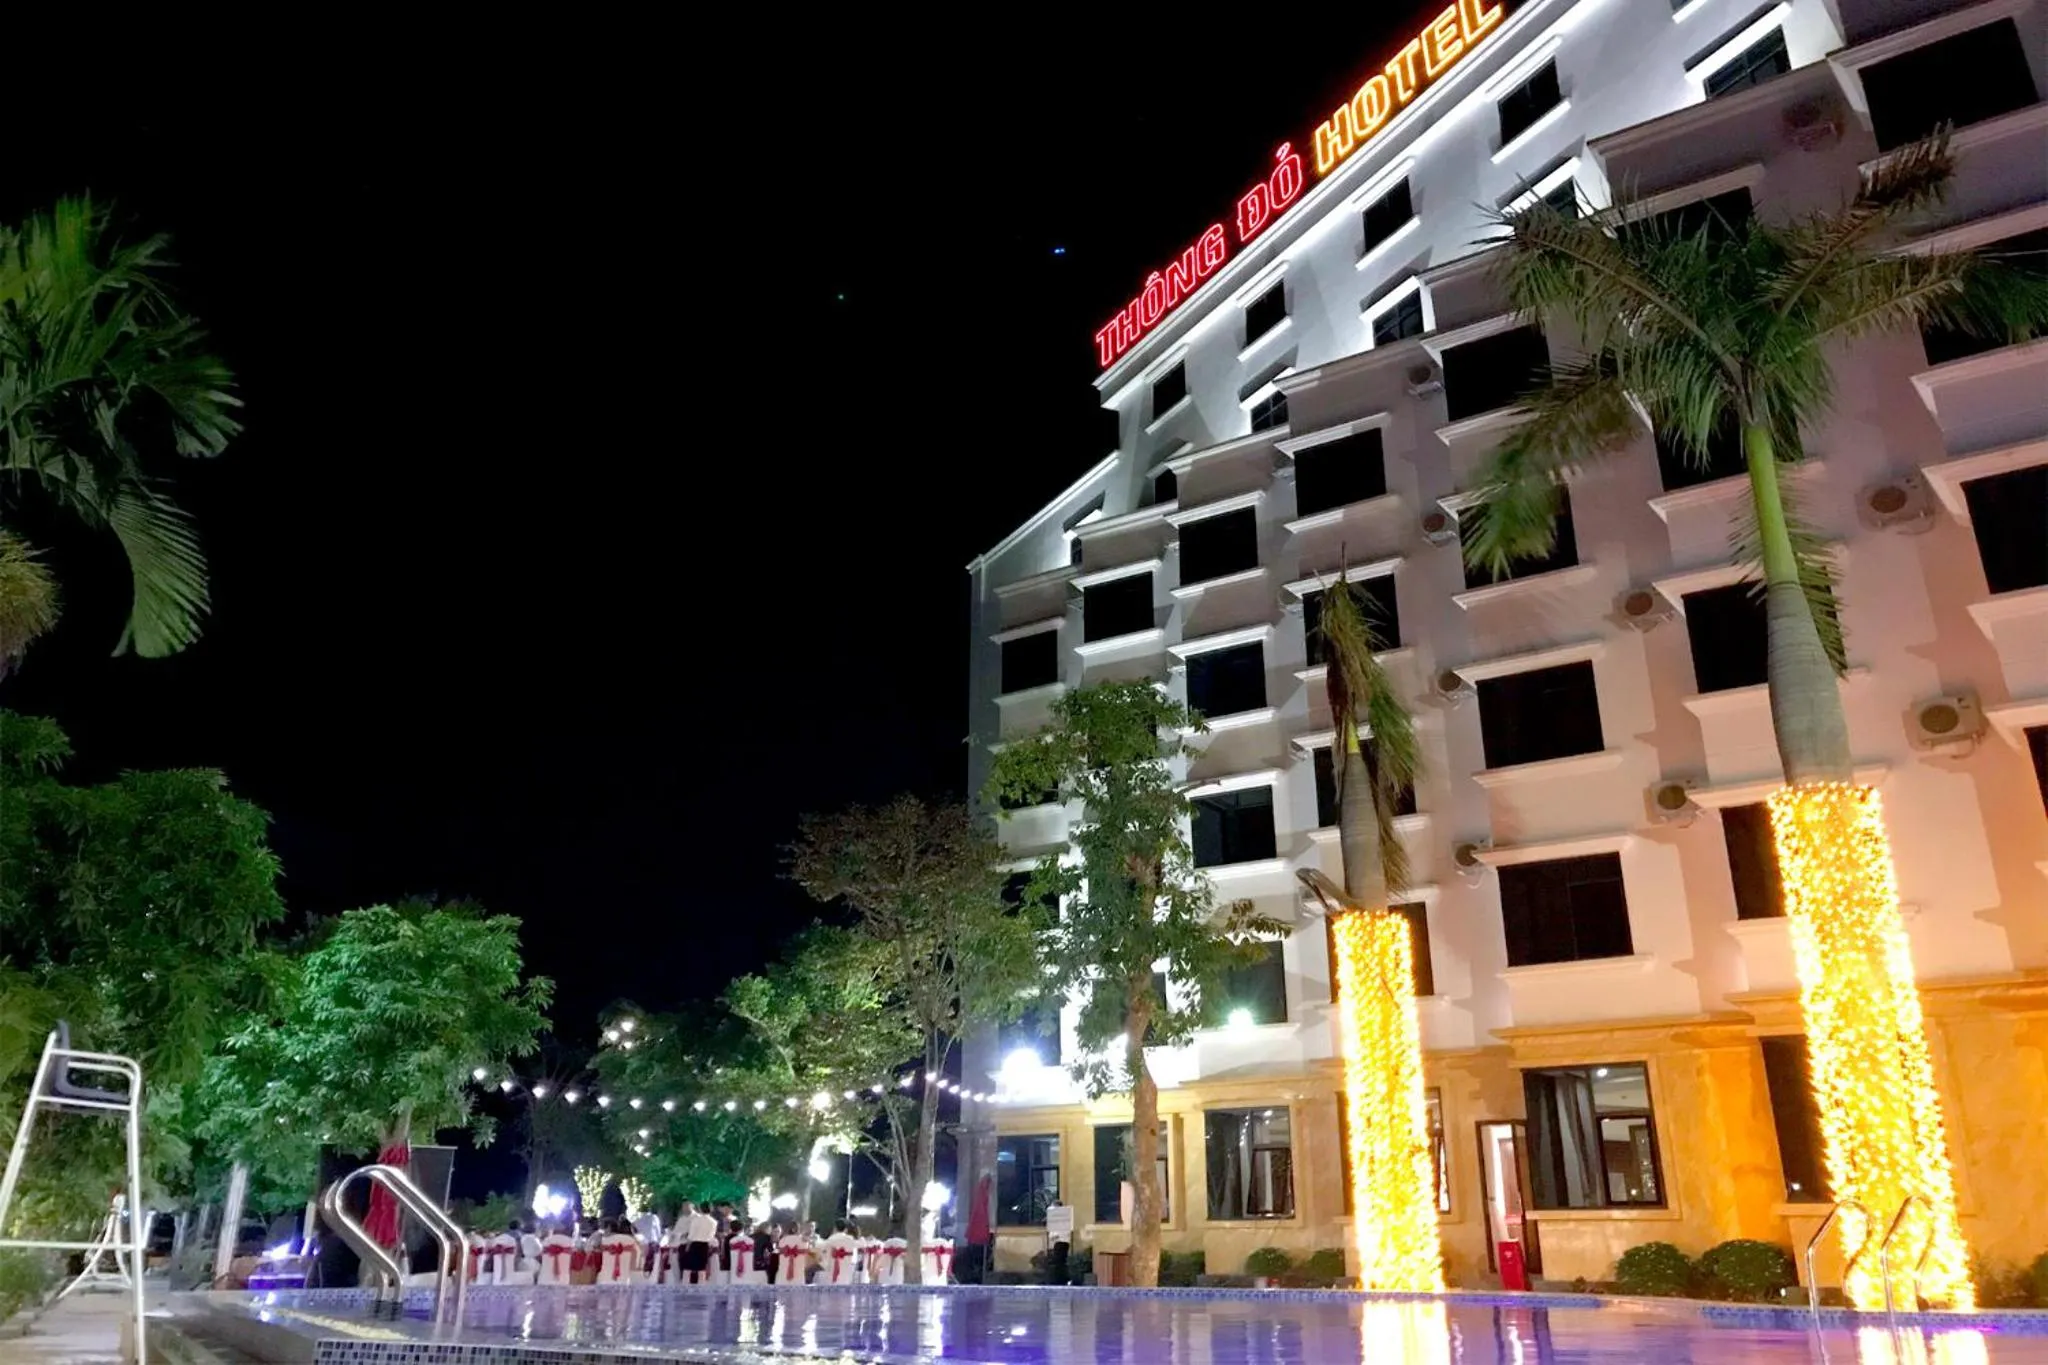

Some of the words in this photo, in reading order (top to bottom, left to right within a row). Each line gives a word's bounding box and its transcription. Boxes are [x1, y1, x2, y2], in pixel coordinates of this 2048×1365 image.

[1095, 223, 1225, 366] THÔNG
[1237, 141, 1302, 242] ĐỎ
[1314, 0, 1502, 174] HOTEL
